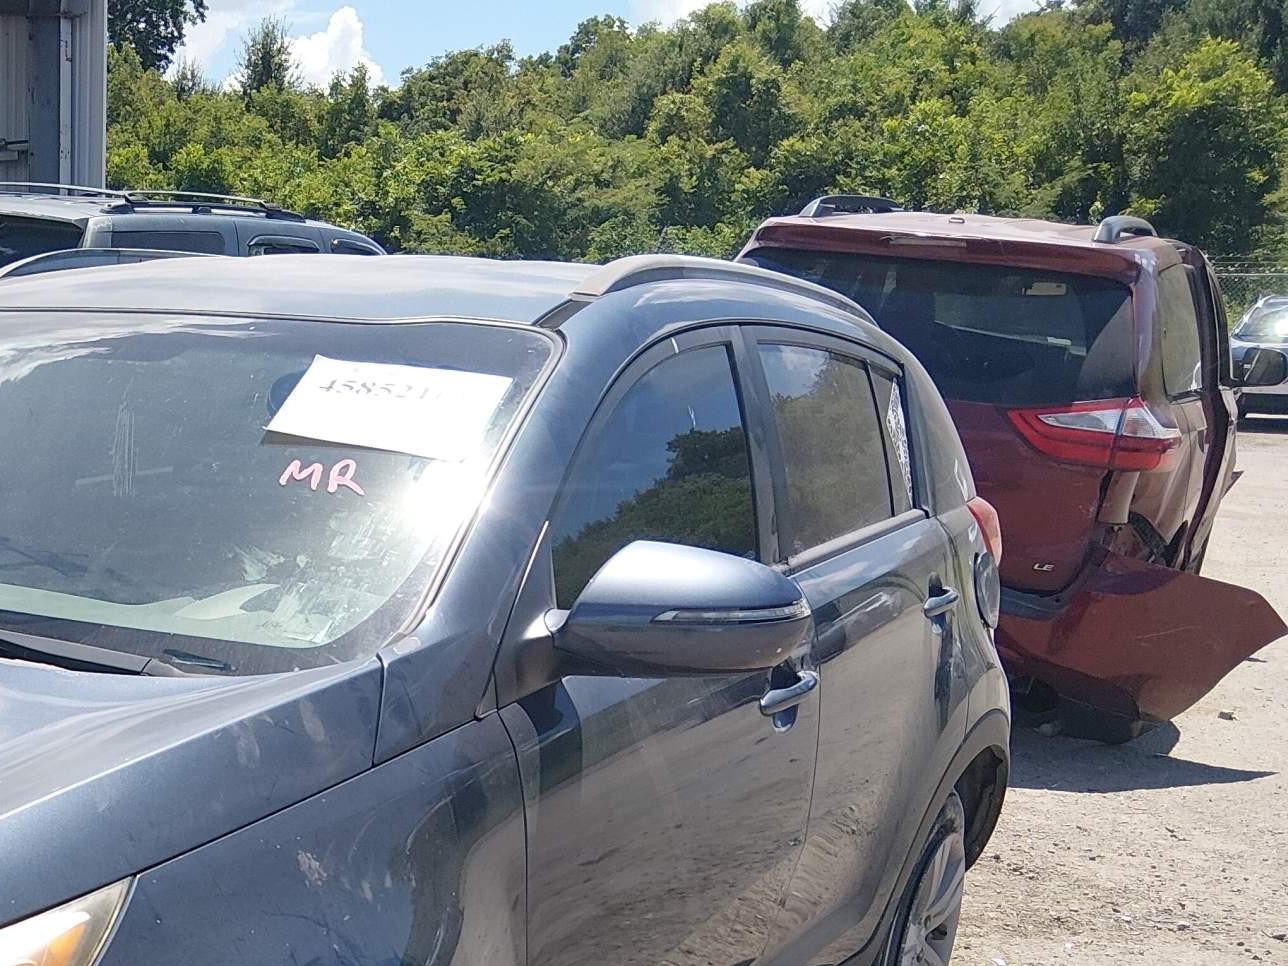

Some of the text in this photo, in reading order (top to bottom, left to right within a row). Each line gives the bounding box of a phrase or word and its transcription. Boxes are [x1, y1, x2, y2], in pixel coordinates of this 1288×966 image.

[318, 376, 464, 400] 458521
[279, 458, 365, 497] MR
[1032, 563, 1055, 572] LE
